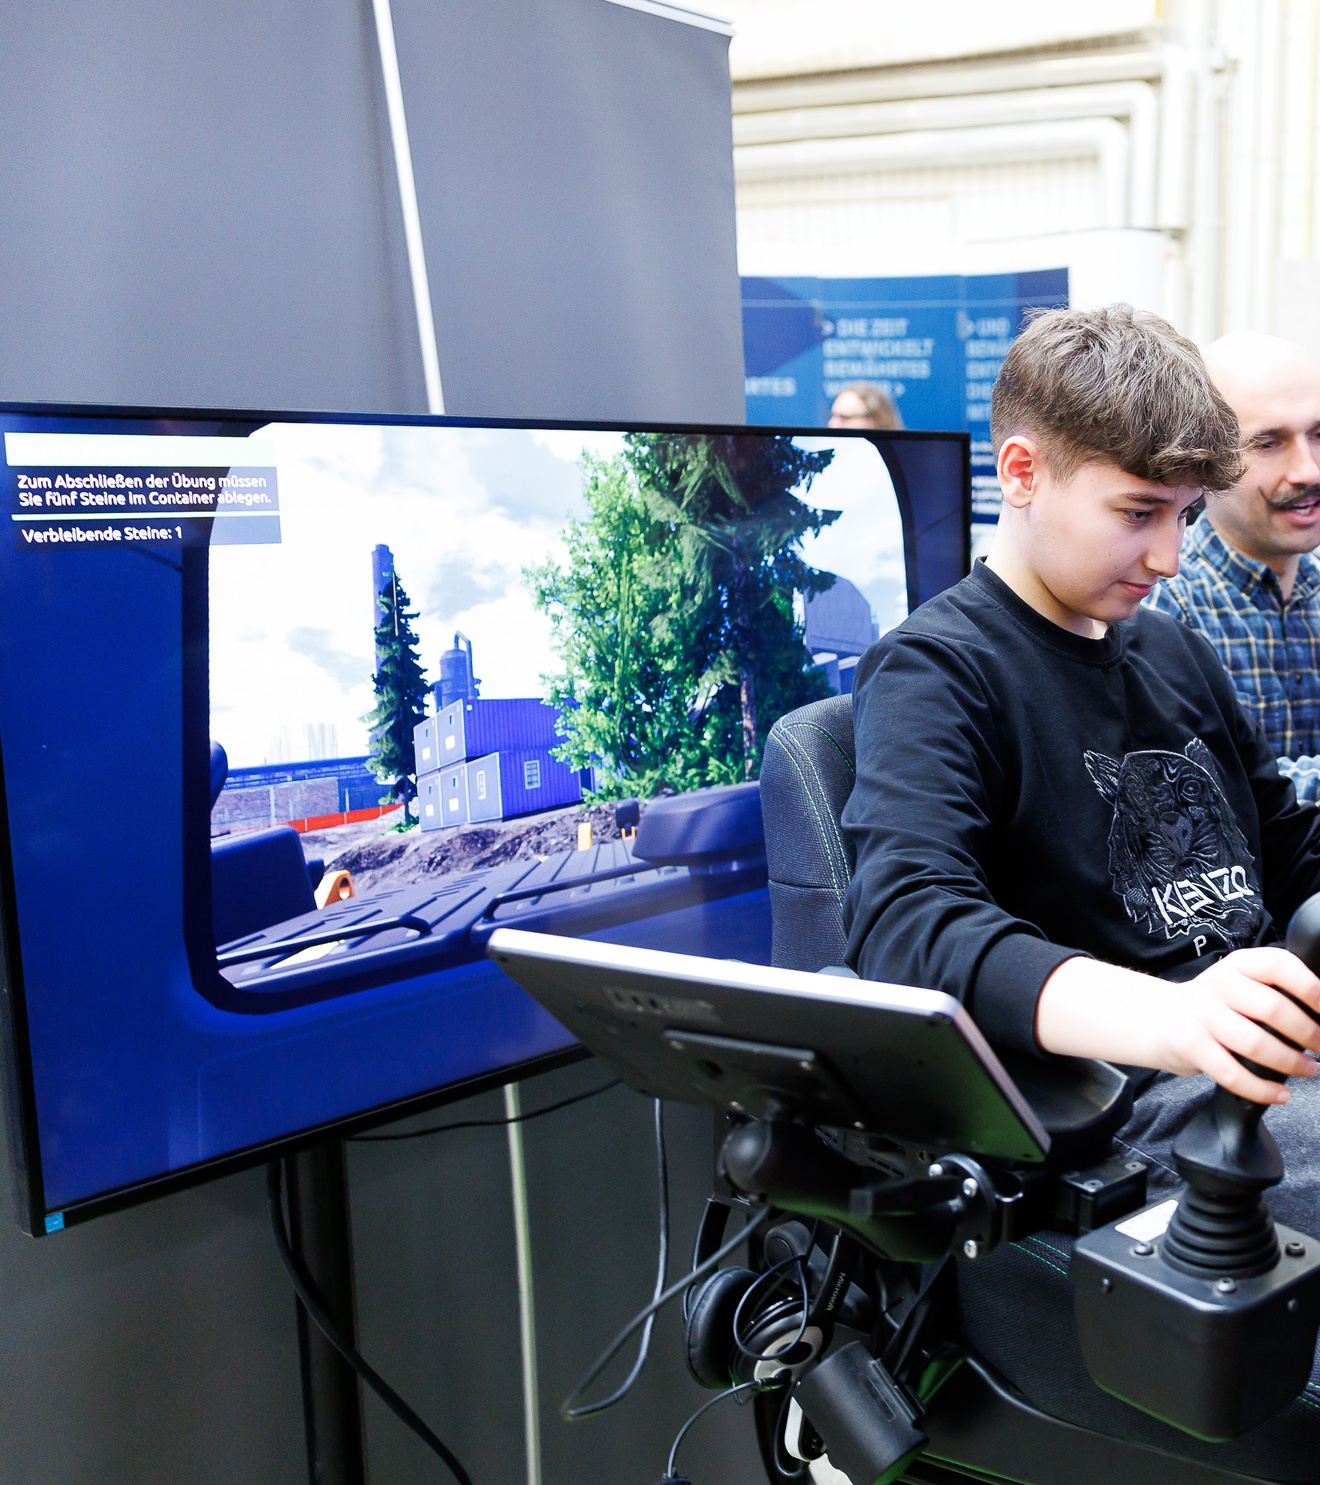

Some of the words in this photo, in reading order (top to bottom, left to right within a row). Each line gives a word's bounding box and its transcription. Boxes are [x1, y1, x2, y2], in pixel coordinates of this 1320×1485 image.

[17, 475, 52, 489] Zum
[55, 474, 143, 489] Abschließen
[146, 474, 169, 488] der
[172, 472, 216, 491] Übung
[218, 475, 267, 488] müssen
[19, 492, 43, 506] Sie
[45, 491, 78, 506] fünf
[80, 491, 127, 505] Steine
[128, 491, 147, 505] im
[149, 491, 214, 505] Container
[217, 492, 272, 507] ablegen.
[22, 526, 122, 543] Verbleibende
[123, 526, 173, 540] Steine:
[175, 526, 183, 539] 1
[1152, 866, 1254, 925] KENZO
[825, 1272, 847, 1311] Microsoft
